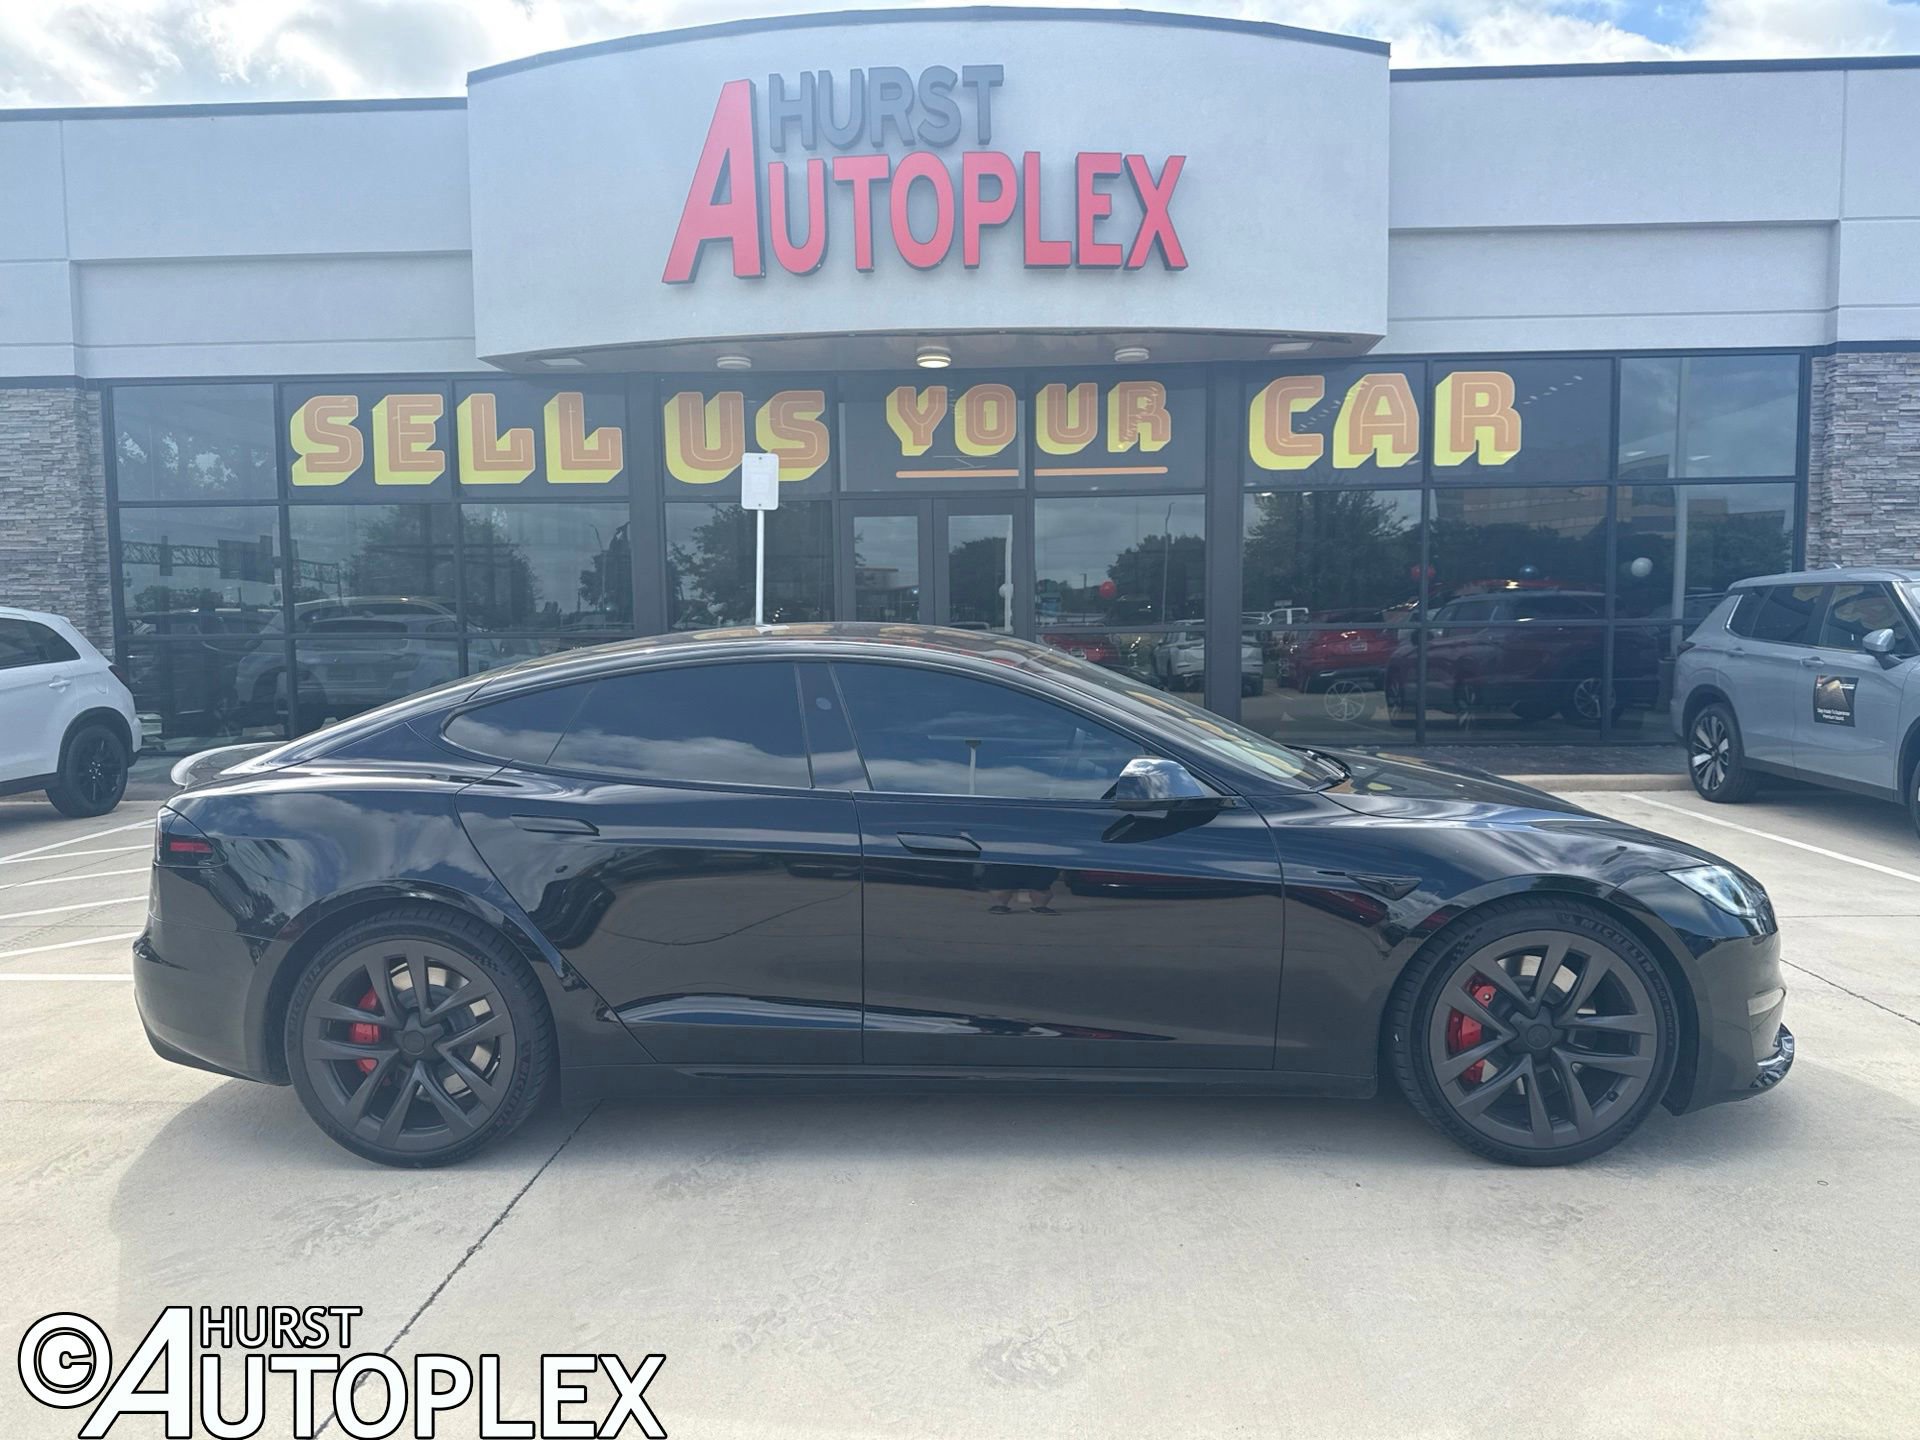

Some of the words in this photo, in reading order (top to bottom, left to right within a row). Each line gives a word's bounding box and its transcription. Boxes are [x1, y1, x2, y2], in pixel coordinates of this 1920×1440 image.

[768, 64, 1005, 152] HURST
[661, 78, 1189, 285] AUTOPLEX
[290, 391, 624, 486] SELL
[664, 390, 830, 484] US
[886, 380, 1172, 456] YOUR
[1249, 371, 1522, 471] CAR
[1580, 917, 1656, 974] MICHELIN
